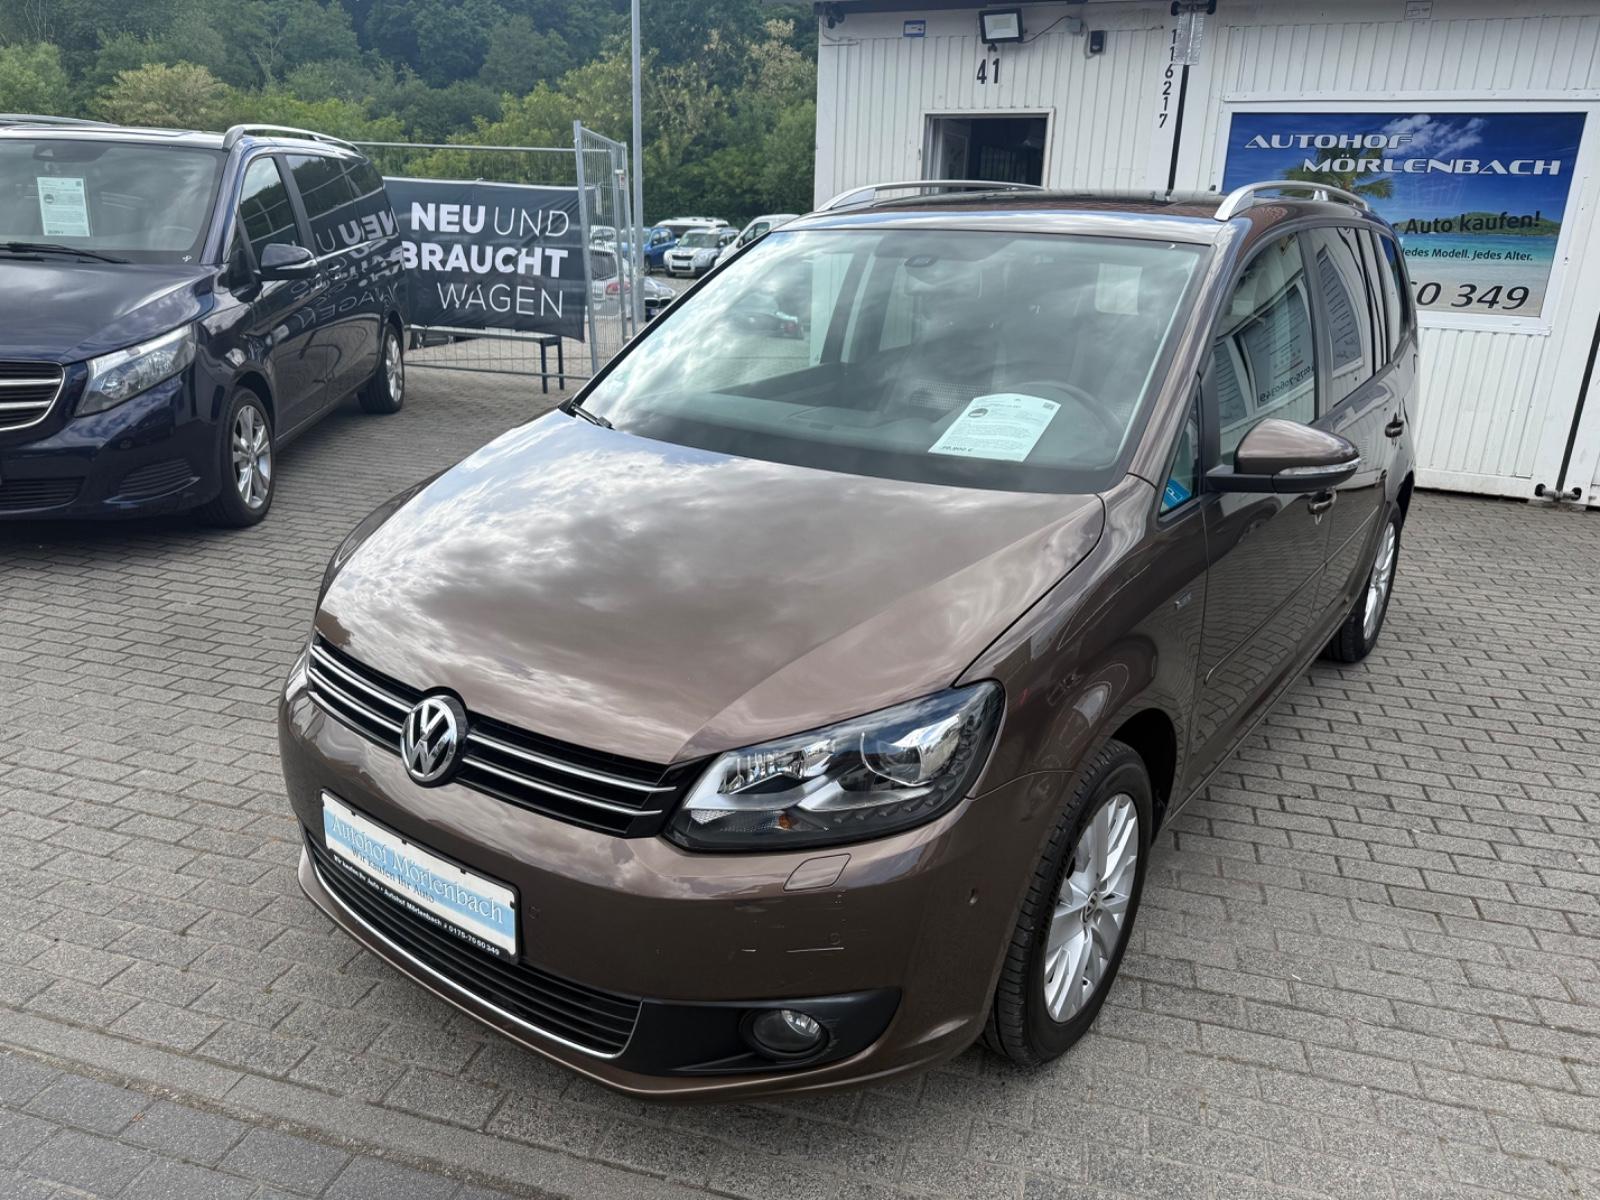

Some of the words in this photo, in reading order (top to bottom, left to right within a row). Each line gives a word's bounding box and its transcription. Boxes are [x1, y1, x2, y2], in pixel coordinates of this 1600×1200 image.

[976, 58, 1000, 85] 41
[1244, 133, 1413, 149] AUTOHOF
[1302, 154, 1561, 176] MÖRLENBACH
[410, 202, 486, 234] NEU
[494, 206, 569, 237] UND
[1404, 217, 1453, 235] Auto
[1459, 211, 1541, 232] kaufen!
[402, 241, 569, 278] BRAUCHT
[1431, 247, 1470, 259] Modell.
[1471, 250, 1502, 261] Jedes
[1504, 251, 1533, 261] Alter.
[437, 282, 563, 318] WAGEN
[1411, 280, 1442, 306] 0
[1450, 283, 1530, 310] 349
[392, 849, 503, 924] Mörlenbach
